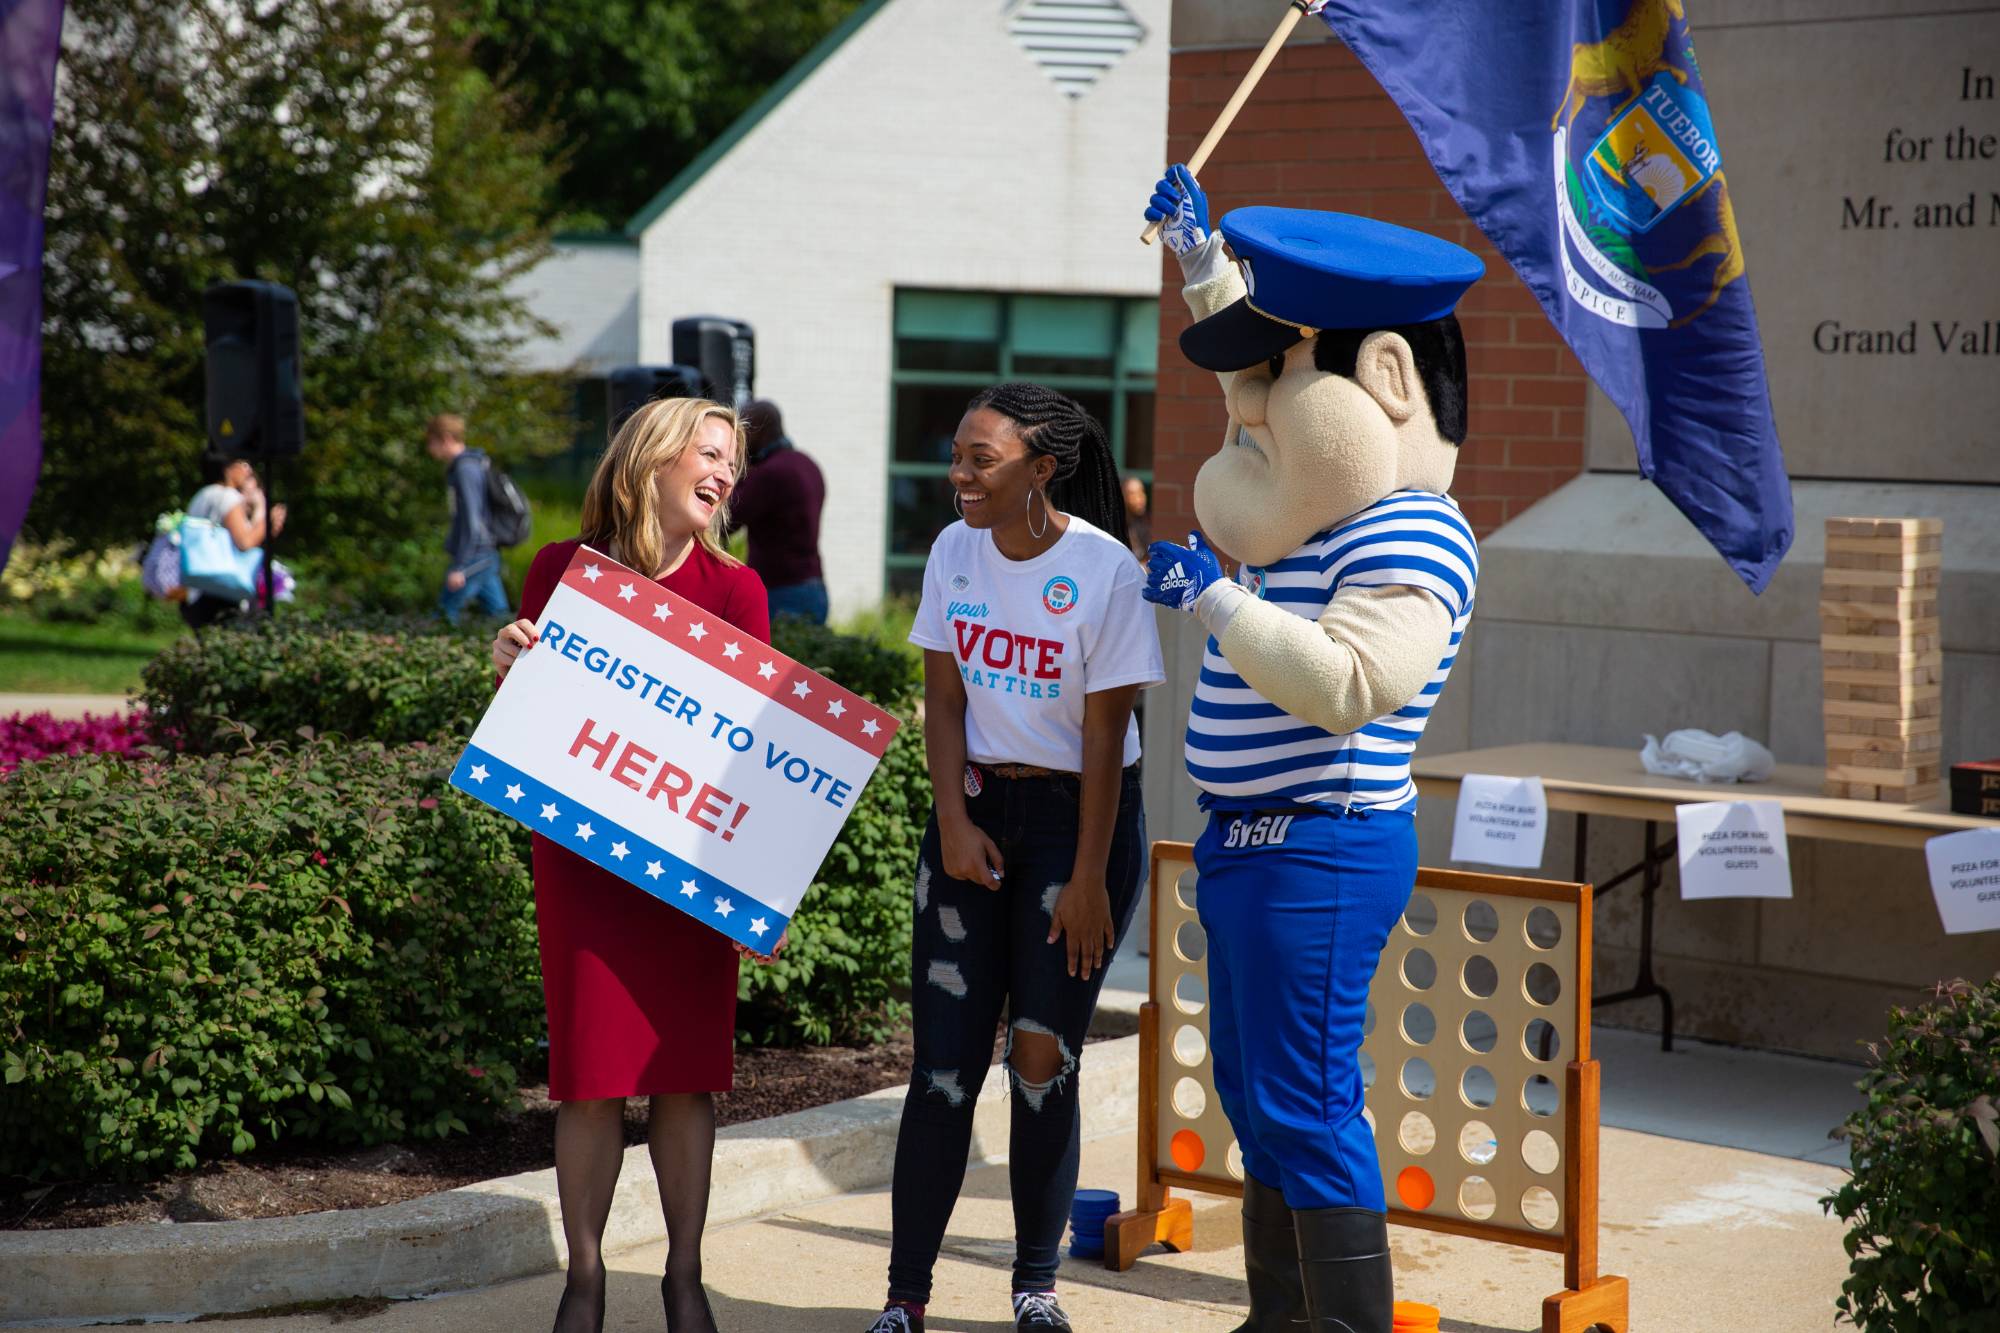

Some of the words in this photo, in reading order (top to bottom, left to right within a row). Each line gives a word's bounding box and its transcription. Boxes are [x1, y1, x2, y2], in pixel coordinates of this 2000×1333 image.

[1960, 67, 1994, 100] In
[1645, 84, 1718, 175] TUEBOR
[1884, 128, 1933, 161] for
[1945, 126, 1997, 160] the
[1841, 195, 1899, 229] Mr.
[1914, 192, 1975, 228] and
[1813, 319, 1917, 355] Grand
[1932, 320, 2000, 355] Vall
[1160, 578, 1189, 592] adidas
[946, 601, 990, 621] your
[954, 619, 1064, 680] VOTE
[960, 663, 1060, 699] MATTERS
[538, 620, 702, 726] REGISTER
[710, 712, 754, 753] TO
[765, 742, 853, 808] VOTE
[567, 718, 750, 843] HERE!
[1224, 815, 1294, 848] GVSU
[1731, 830, 1748, 840] FOR
[1951, 862, 1978, 873] PIZZA
[1981, 858, 1999, 870] FOR
